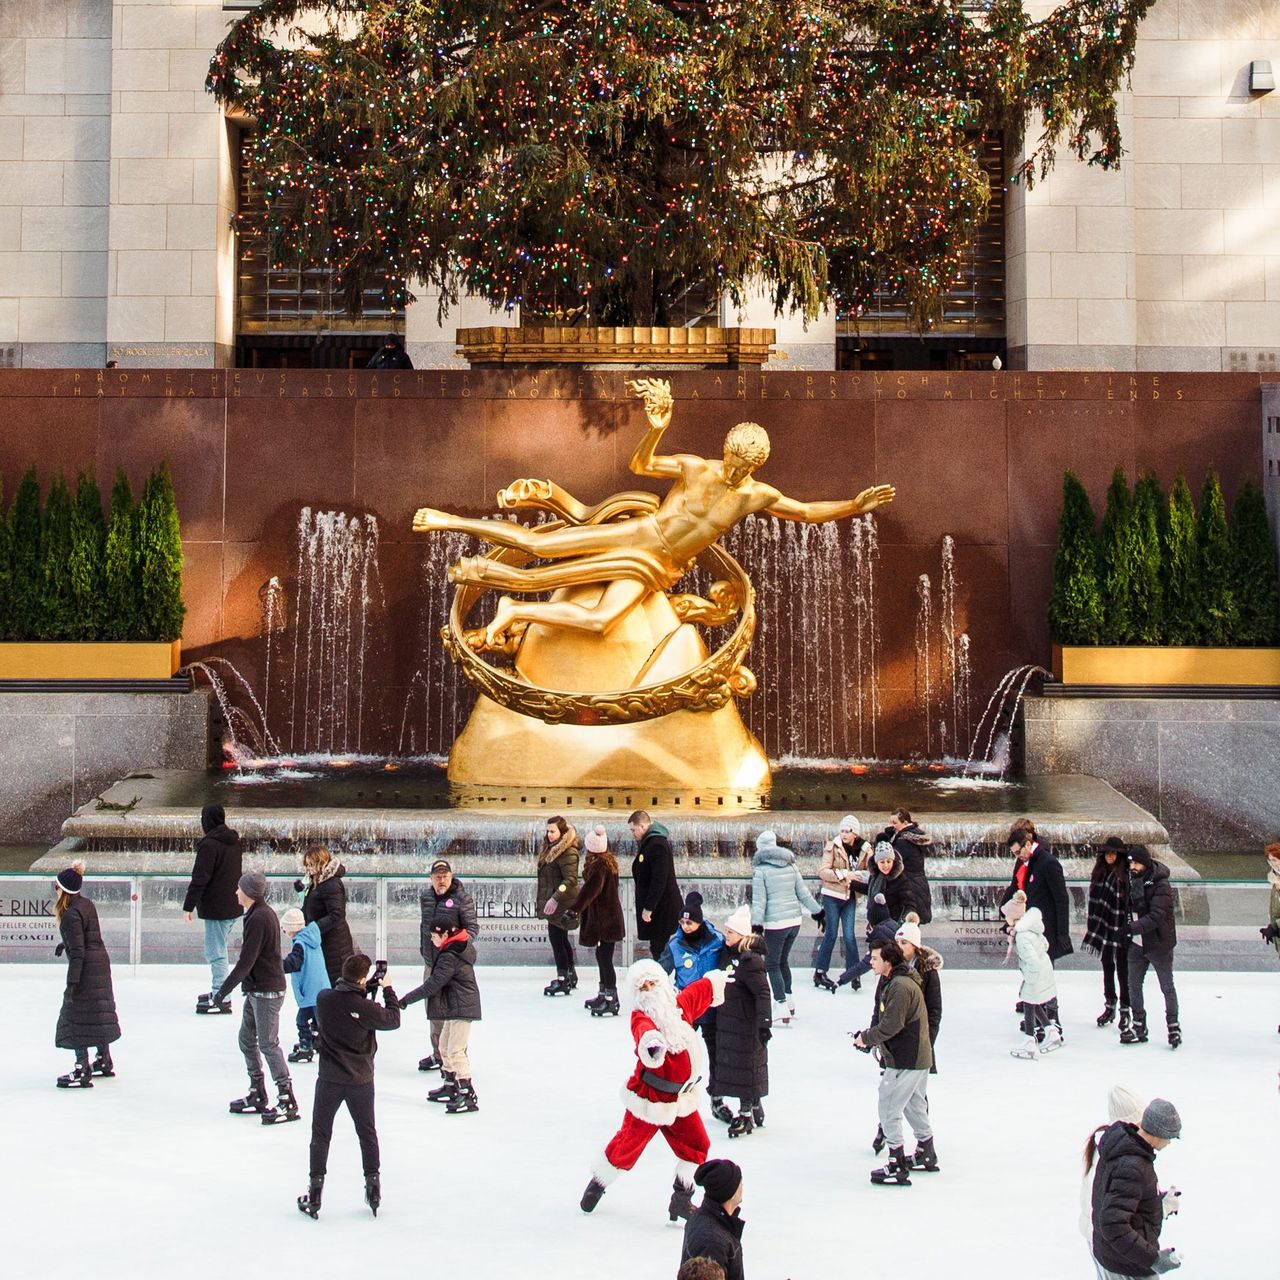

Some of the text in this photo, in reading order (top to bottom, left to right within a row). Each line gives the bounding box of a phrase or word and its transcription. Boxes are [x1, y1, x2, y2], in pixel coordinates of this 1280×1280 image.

[714, 376, 768, 386] ART
[990, 376, 1044, 386] THE
[1083, 376, 1161, 386] FIRE
[52, 387, 126, 397] THAT
[165, 387, 241, 397] HATH
[279, 387, 401, 398] PROVED
[507, 388, 632, 399] MORTAL
[737, 389, 837, 399] MEANS
[876, 389, 907, 400] TO
[1107, 389, 1184, 400] ENDS
[11, 900, 52, 916] RINK
[476, 902, 538, 918] HE RIN
[1, 934, 9, 943] by
